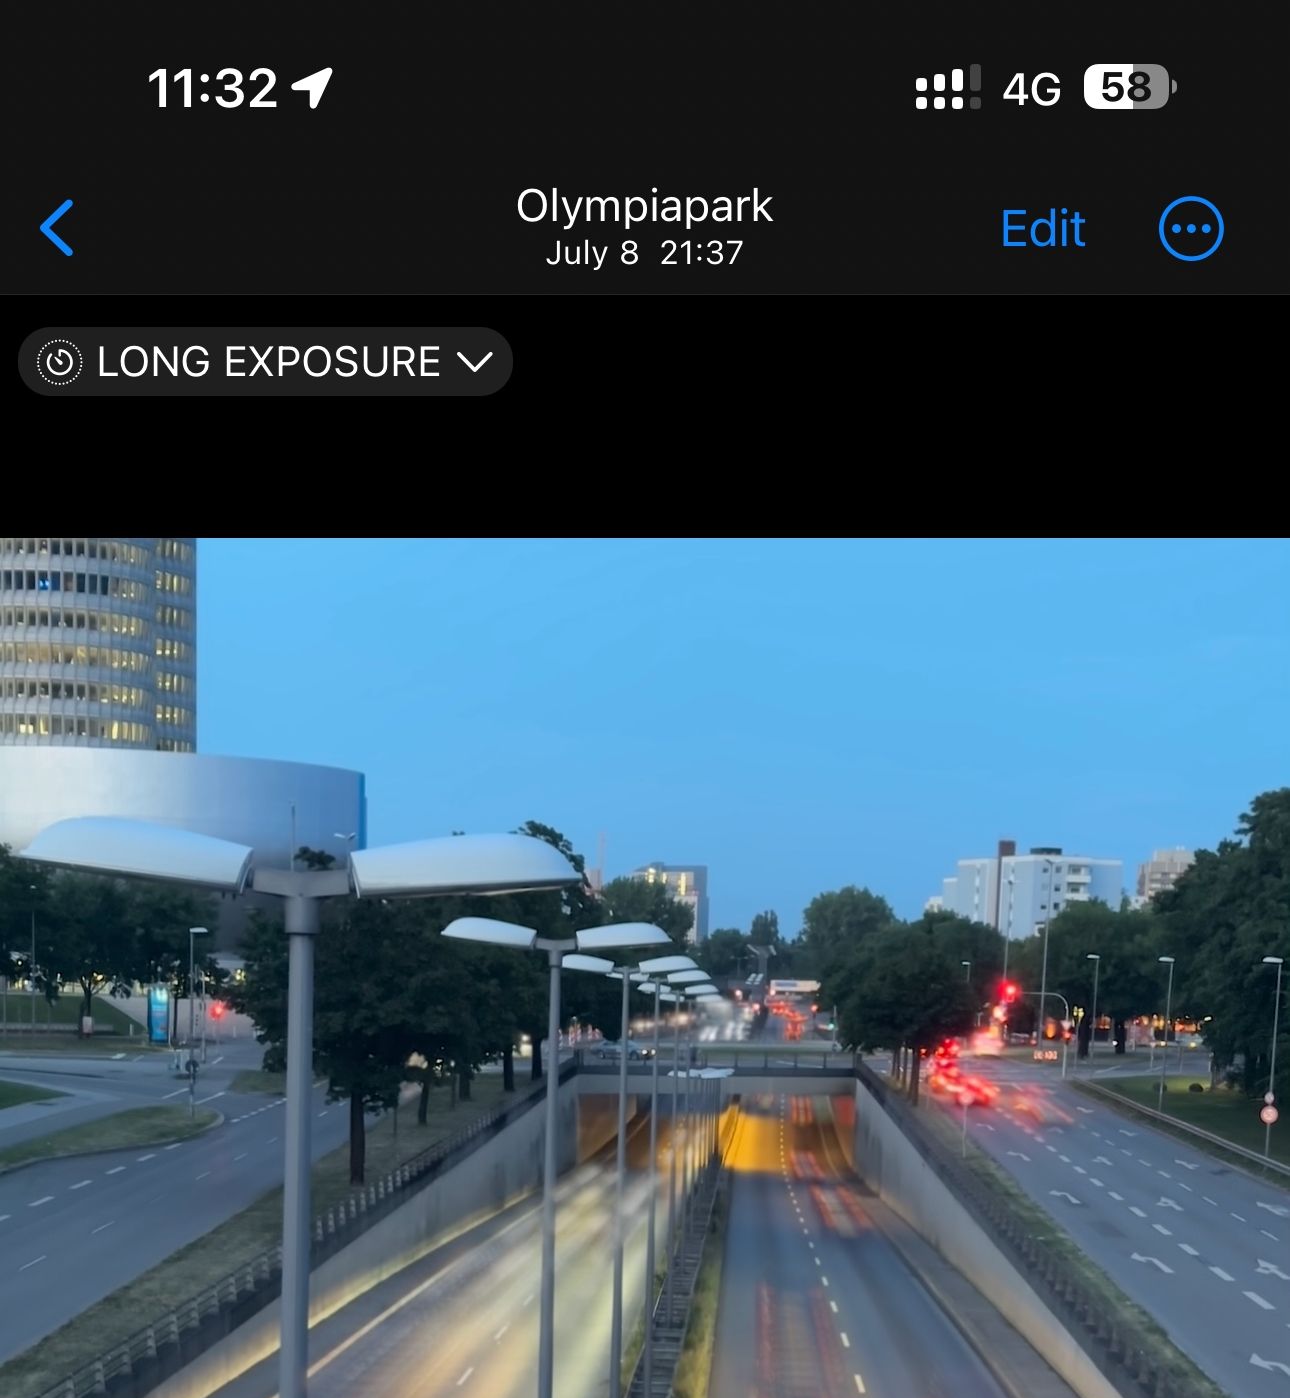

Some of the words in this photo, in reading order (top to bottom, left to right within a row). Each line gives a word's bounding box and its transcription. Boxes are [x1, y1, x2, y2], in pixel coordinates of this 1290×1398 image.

[147, 67, 279, 109] 11:32
[1002, 71, 1062, 107] 4G
[1101, 71, 1152, 102] 58
[517, 186, 774, 230] Olympiapark
[1002, 207, 1087, 248] Edit
[545, 239, 609, 271] July
[620, 240, 639, 266] 8
[660, 240, 744, 266] 21:37
[99, 345, 211, 378] LONG
[226, 345, 440, 378] EXPOSURE
